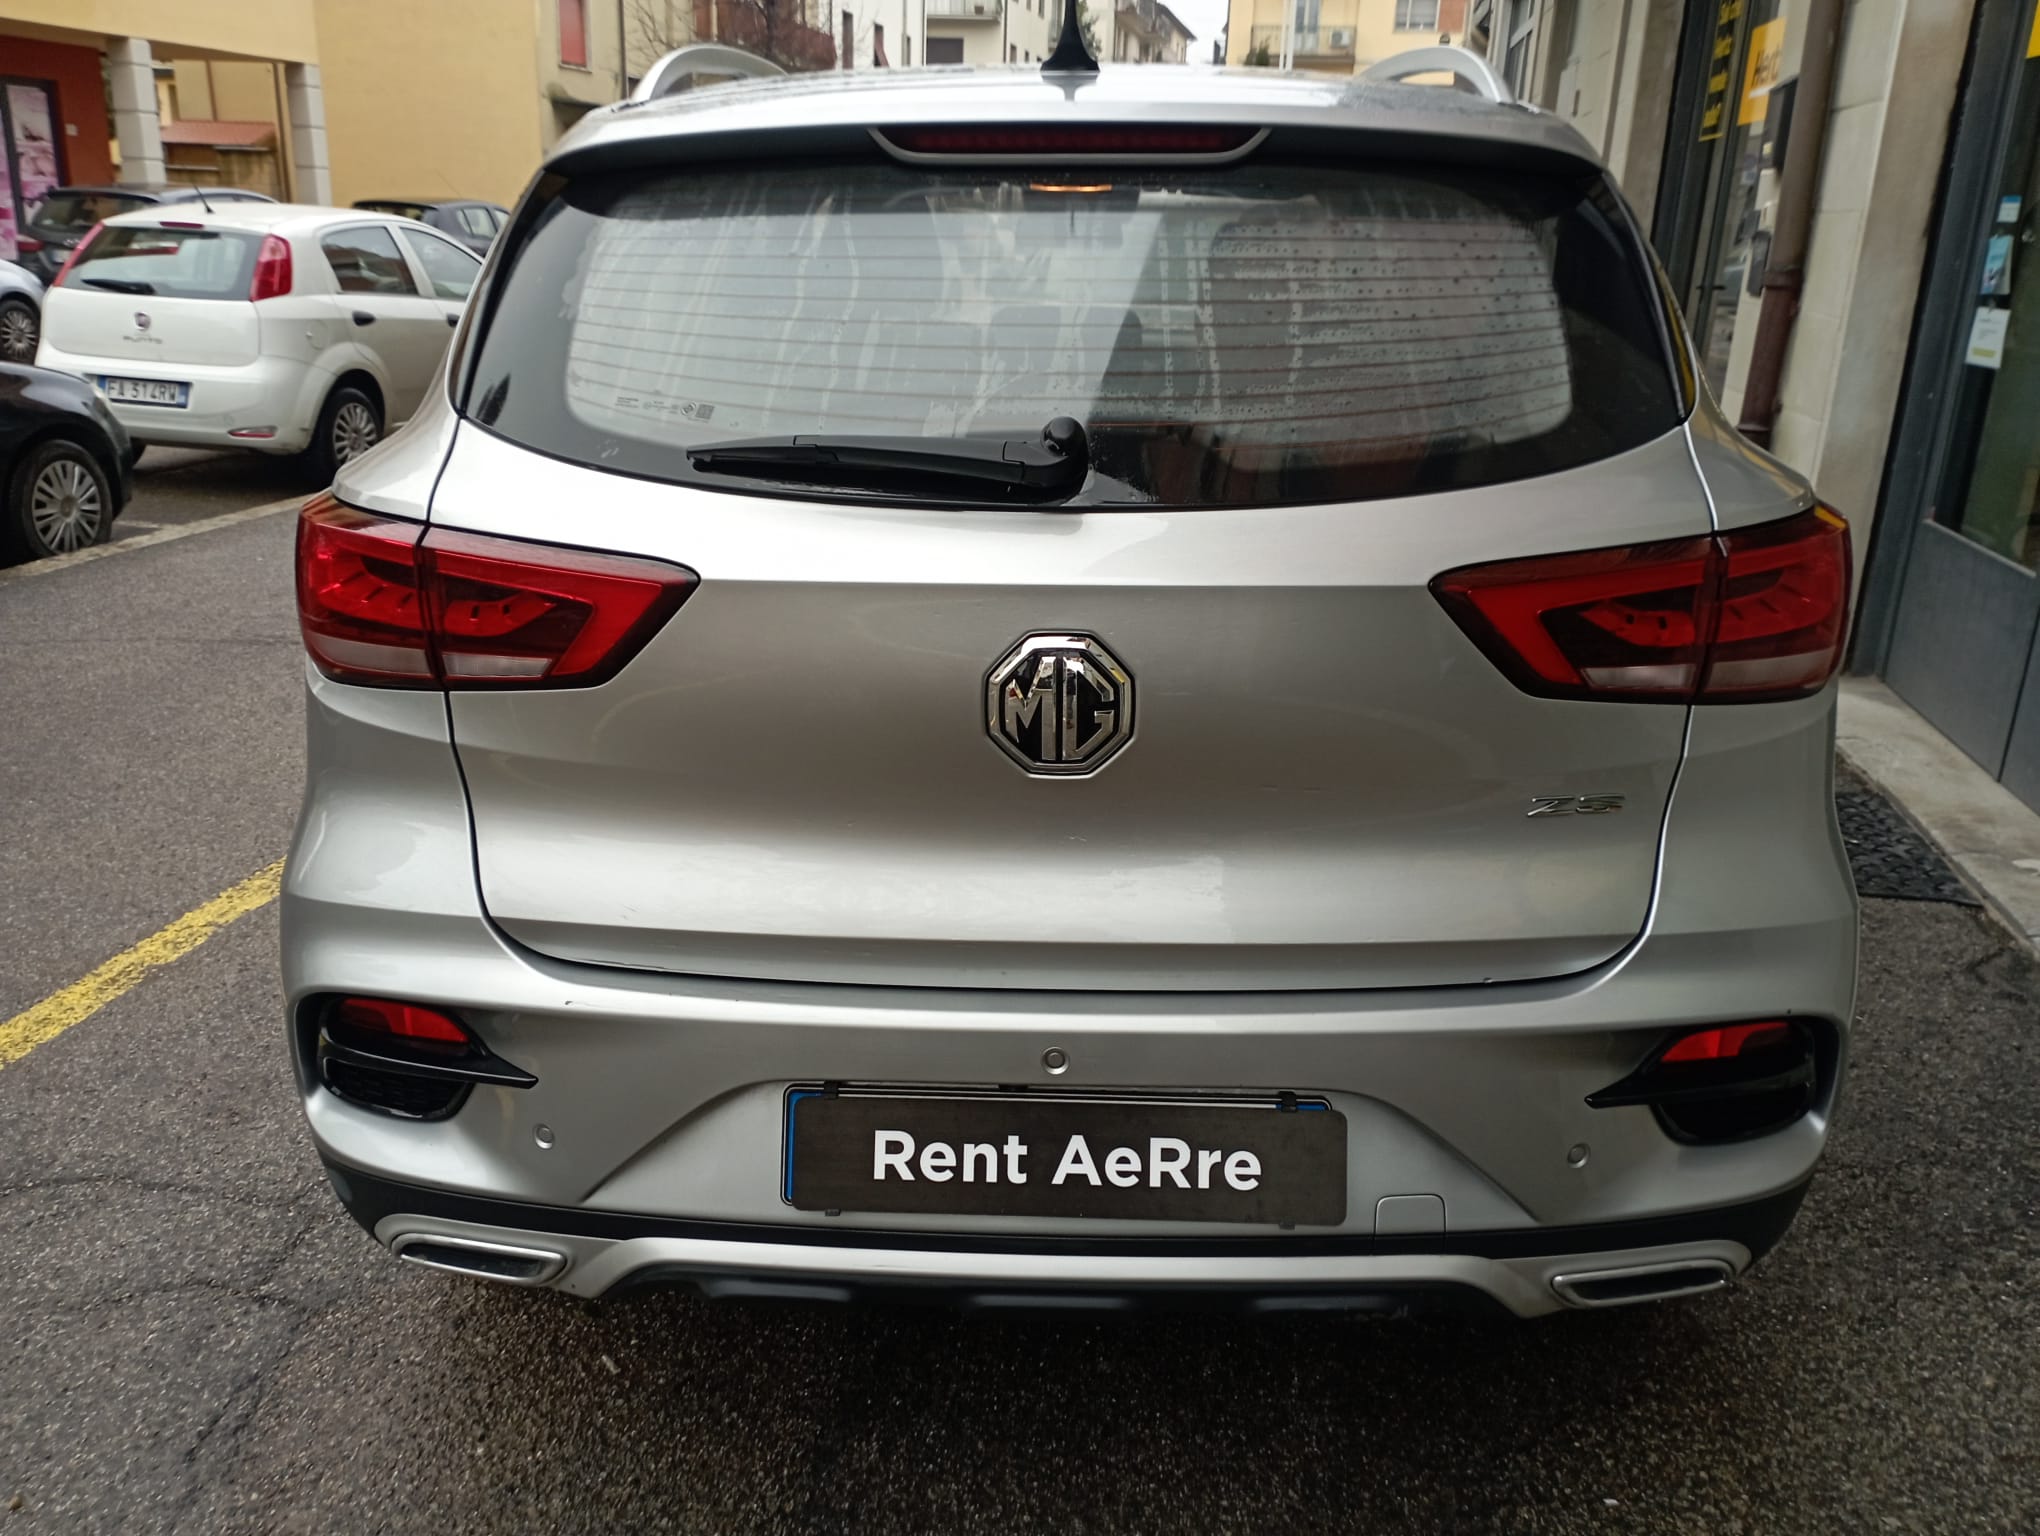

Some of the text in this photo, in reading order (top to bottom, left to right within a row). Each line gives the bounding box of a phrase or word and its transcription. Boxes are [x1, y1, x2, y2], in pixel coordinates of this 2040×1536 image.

[1004, 655, 1115, 761] MG
[1526, 793, 1625, 817] ZS
[874, 1130, 1261, 1190] Rent AeRre
